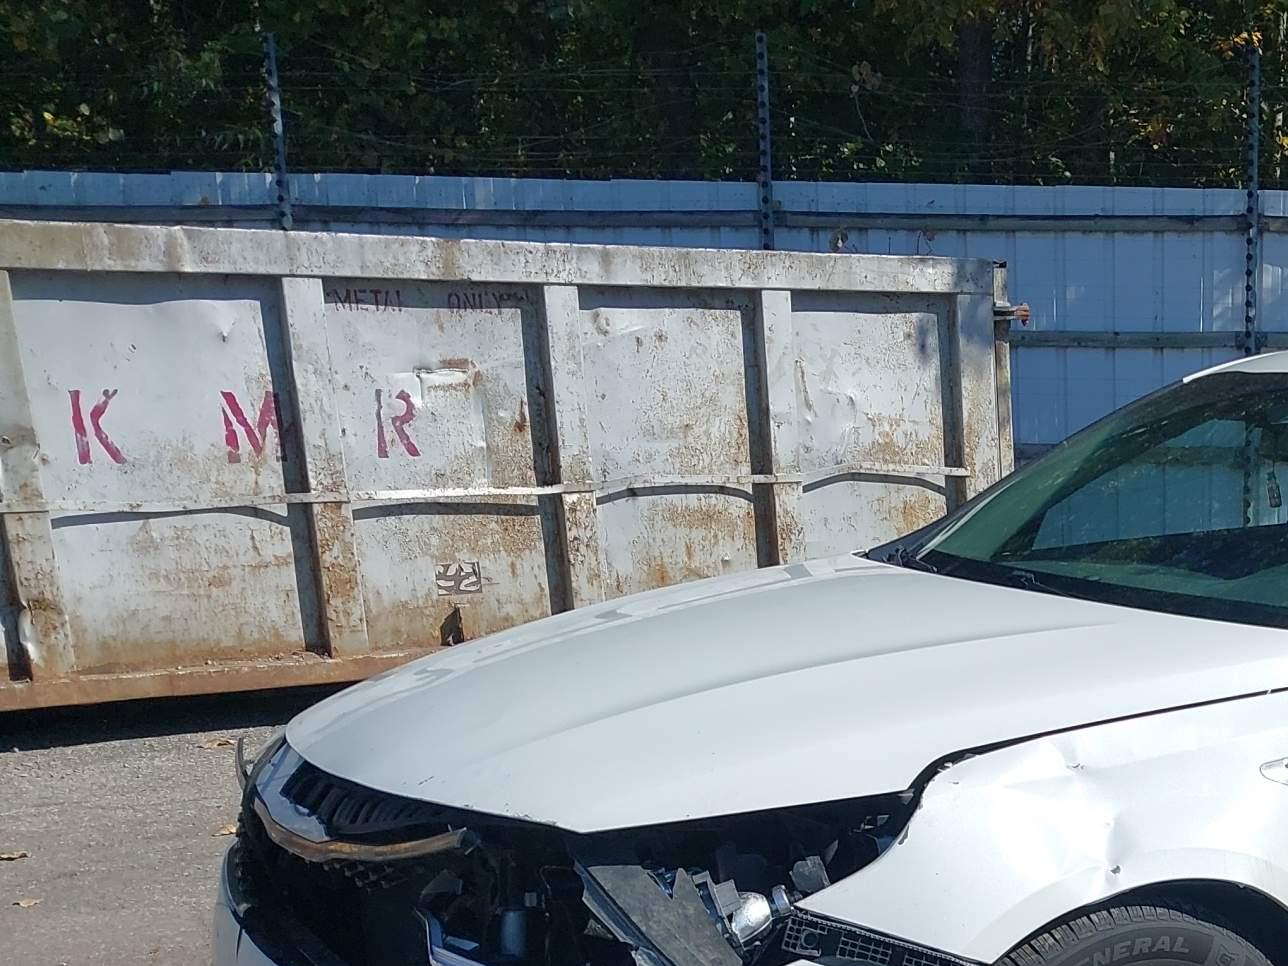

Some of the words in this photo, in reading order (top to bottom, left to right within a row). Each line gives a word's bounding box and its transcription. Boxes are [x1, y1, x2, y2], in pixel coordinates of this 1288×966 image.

[68, 389, 127, 464] K
[220, 389, 288, 463] M
[374, 388, 422, 459] R
